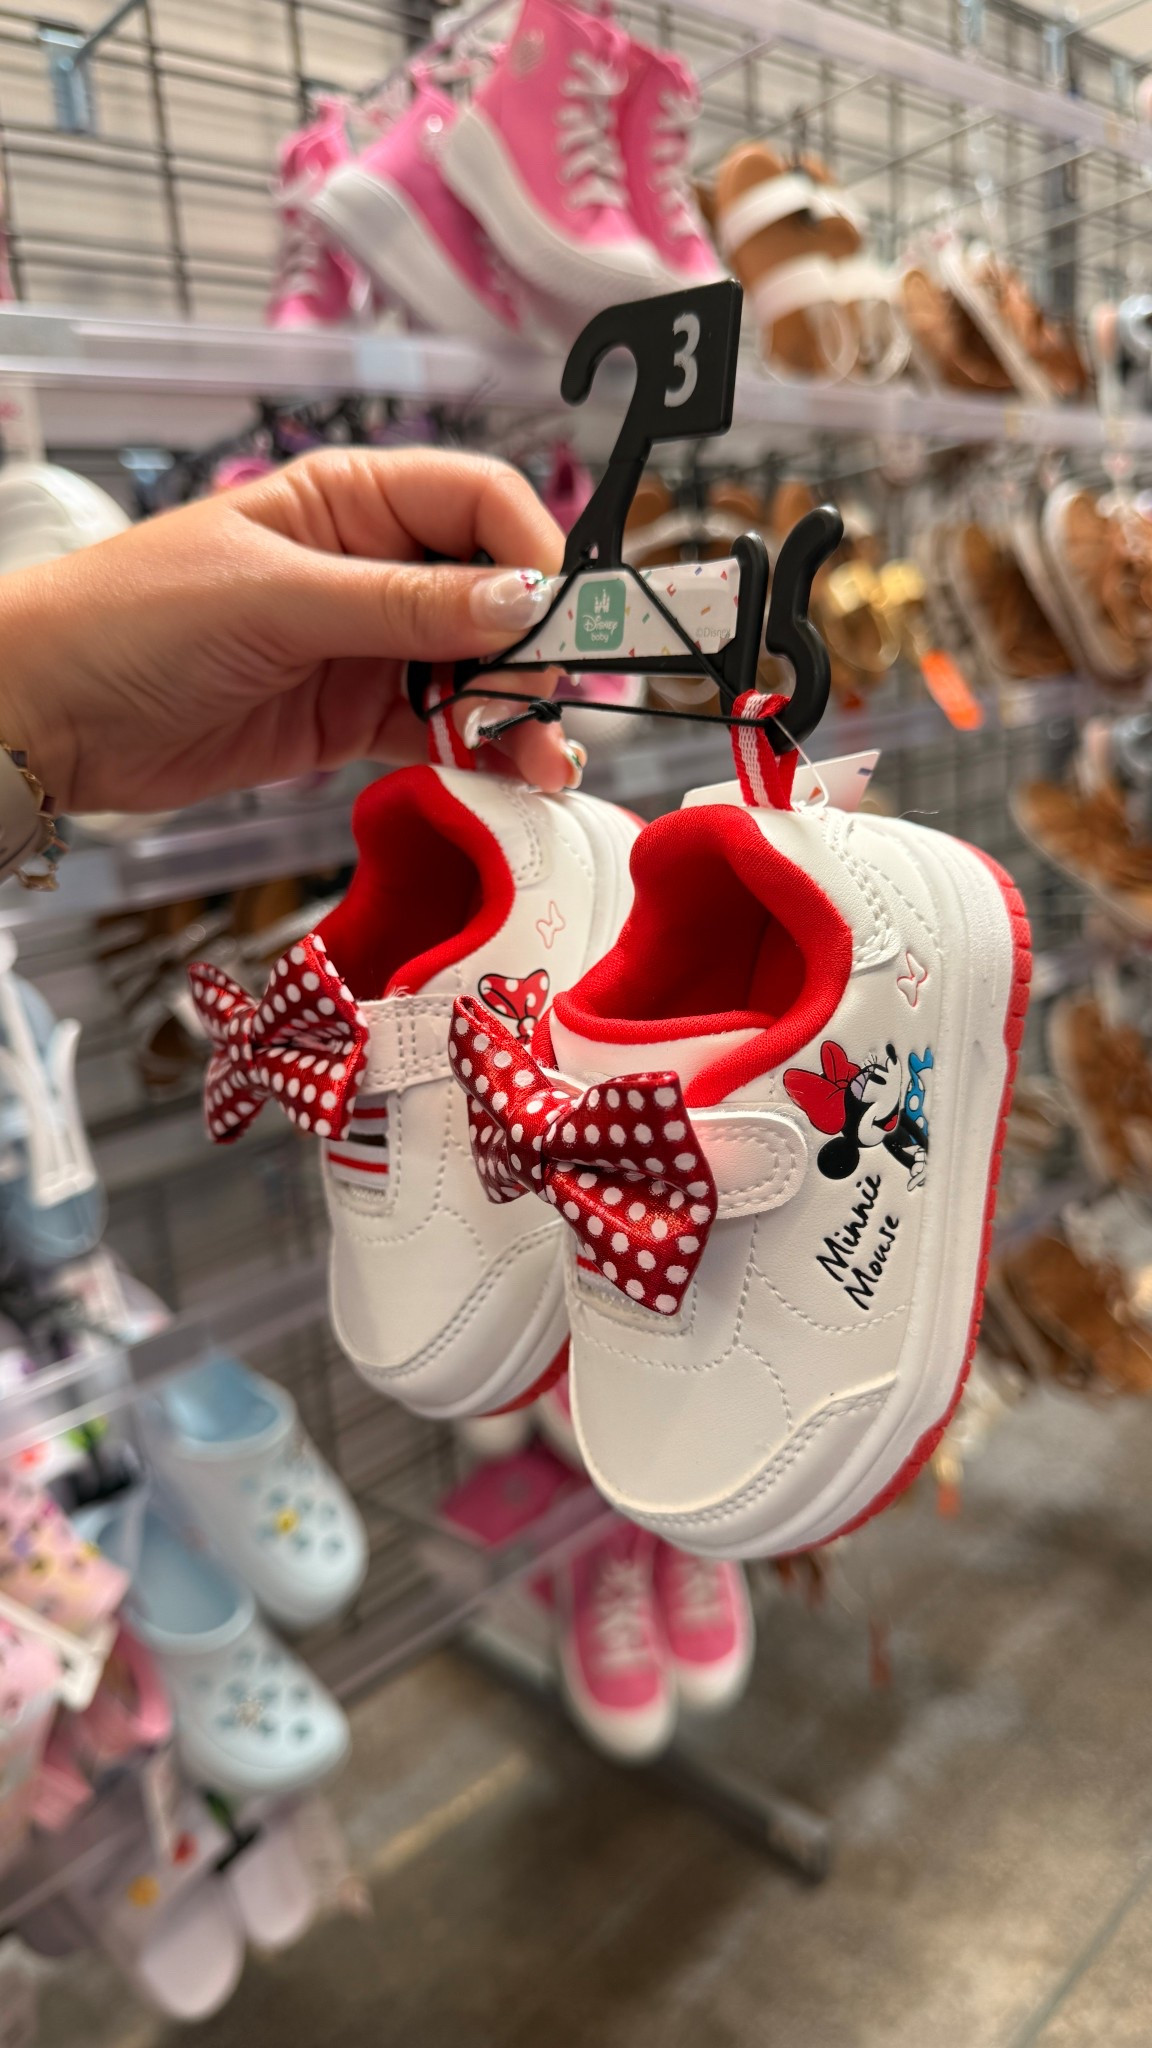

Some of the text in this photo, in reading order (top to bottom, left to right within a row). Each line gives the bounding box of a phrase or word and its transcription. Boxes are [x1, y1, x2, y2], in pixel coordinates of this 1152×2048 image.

[664, 313, 700, 408] 3
[582, 614, 618, 635] Disney
[591, 632, 609, 643] baby
[816, 1174, 881, 1282] Minnie
[843, 1215, 899, 1311] Mouse
